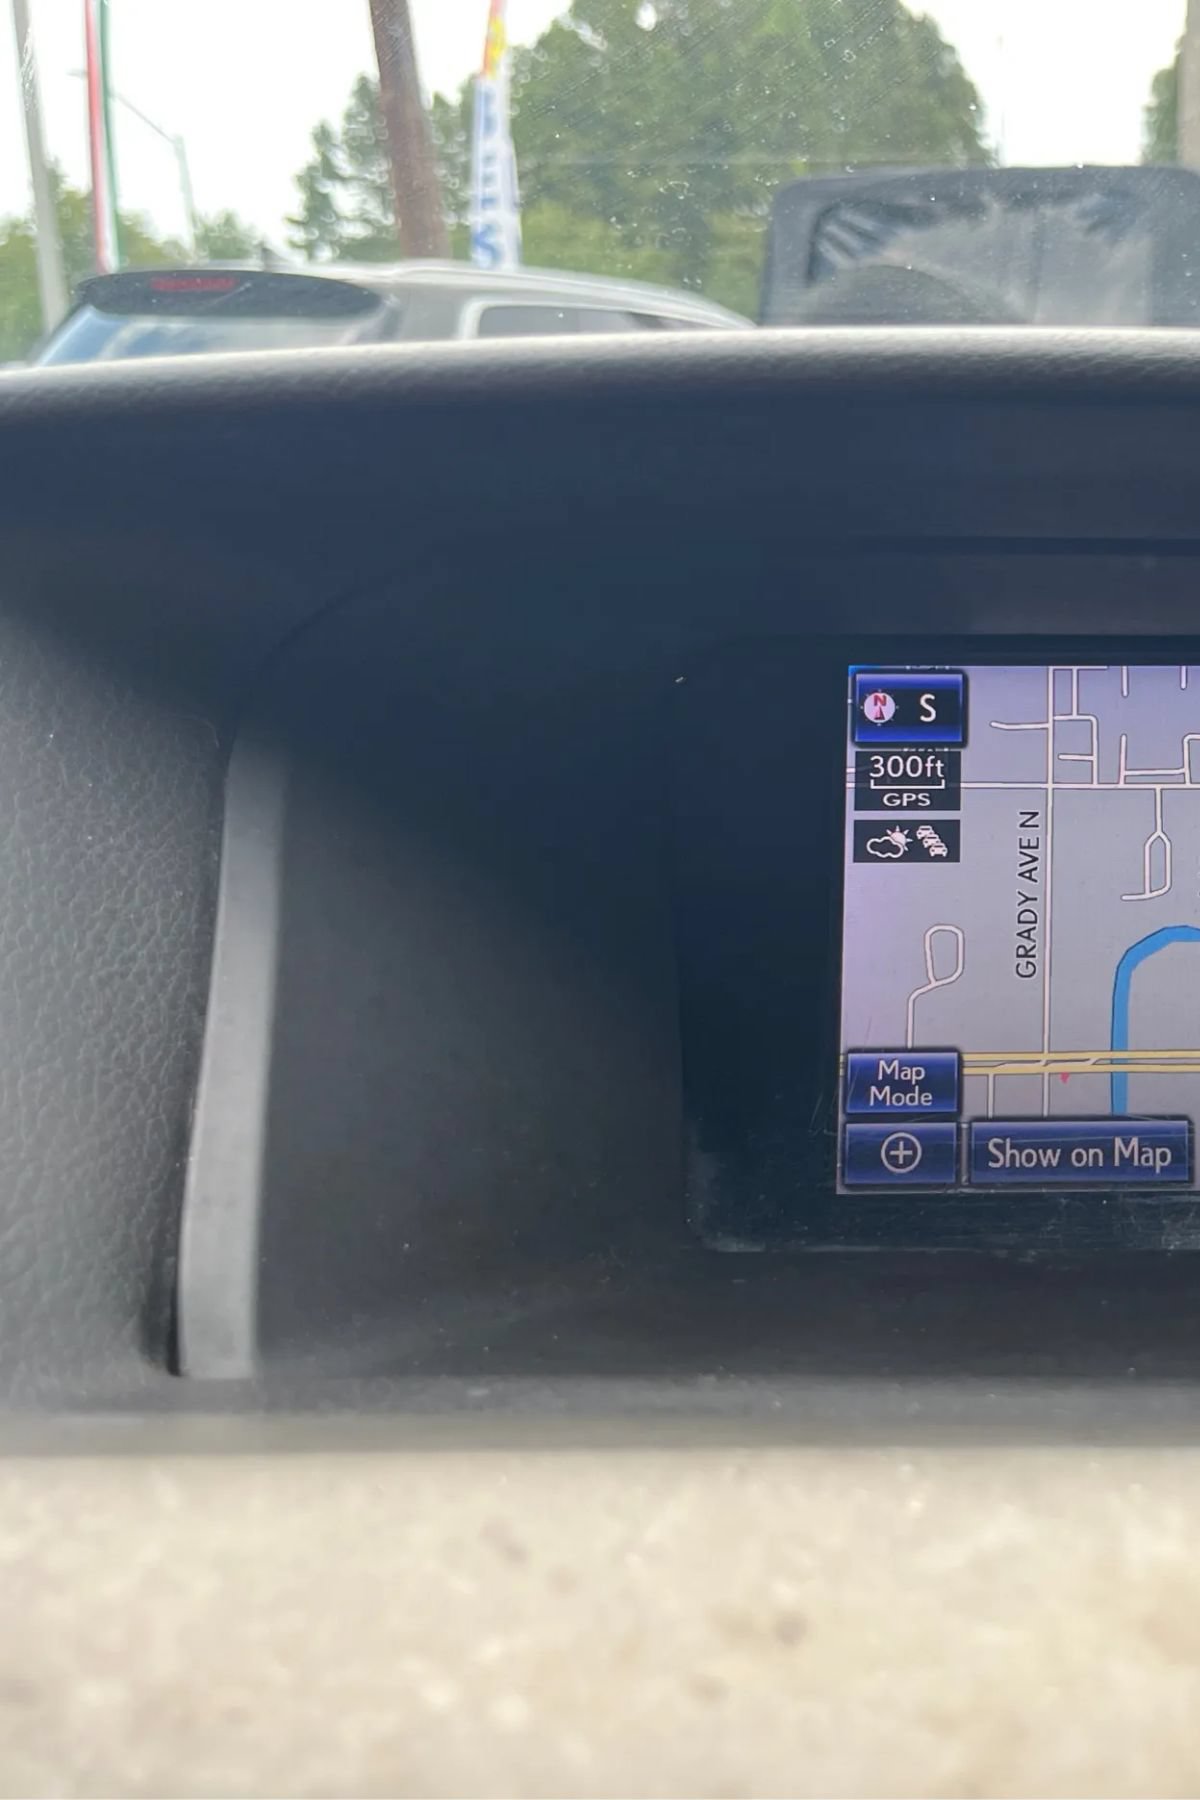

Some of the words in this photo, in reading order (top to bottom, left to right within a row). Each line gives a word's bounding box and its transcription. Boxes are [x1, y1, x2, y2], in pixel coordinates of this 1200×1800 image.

[874, 695, 887, 706] N
[919, 693, 937, 723] S
[869, 755, 945, 778] 300ft
[882, 792, 931, 807] GPS
[1019, 811, 1040, 828] N
[1017, 837, 1040, 883] AVE
[1015, 891, 1038, 978] GRADY
[877, 1059, 926, 1082] Map
[869, 1085, 933, 1107] Mode
[987, 1137, 1061, 1169] Show
[1071, 1147, 1104, 1168] on
[1113, 1136, 1172, 1174] Map
